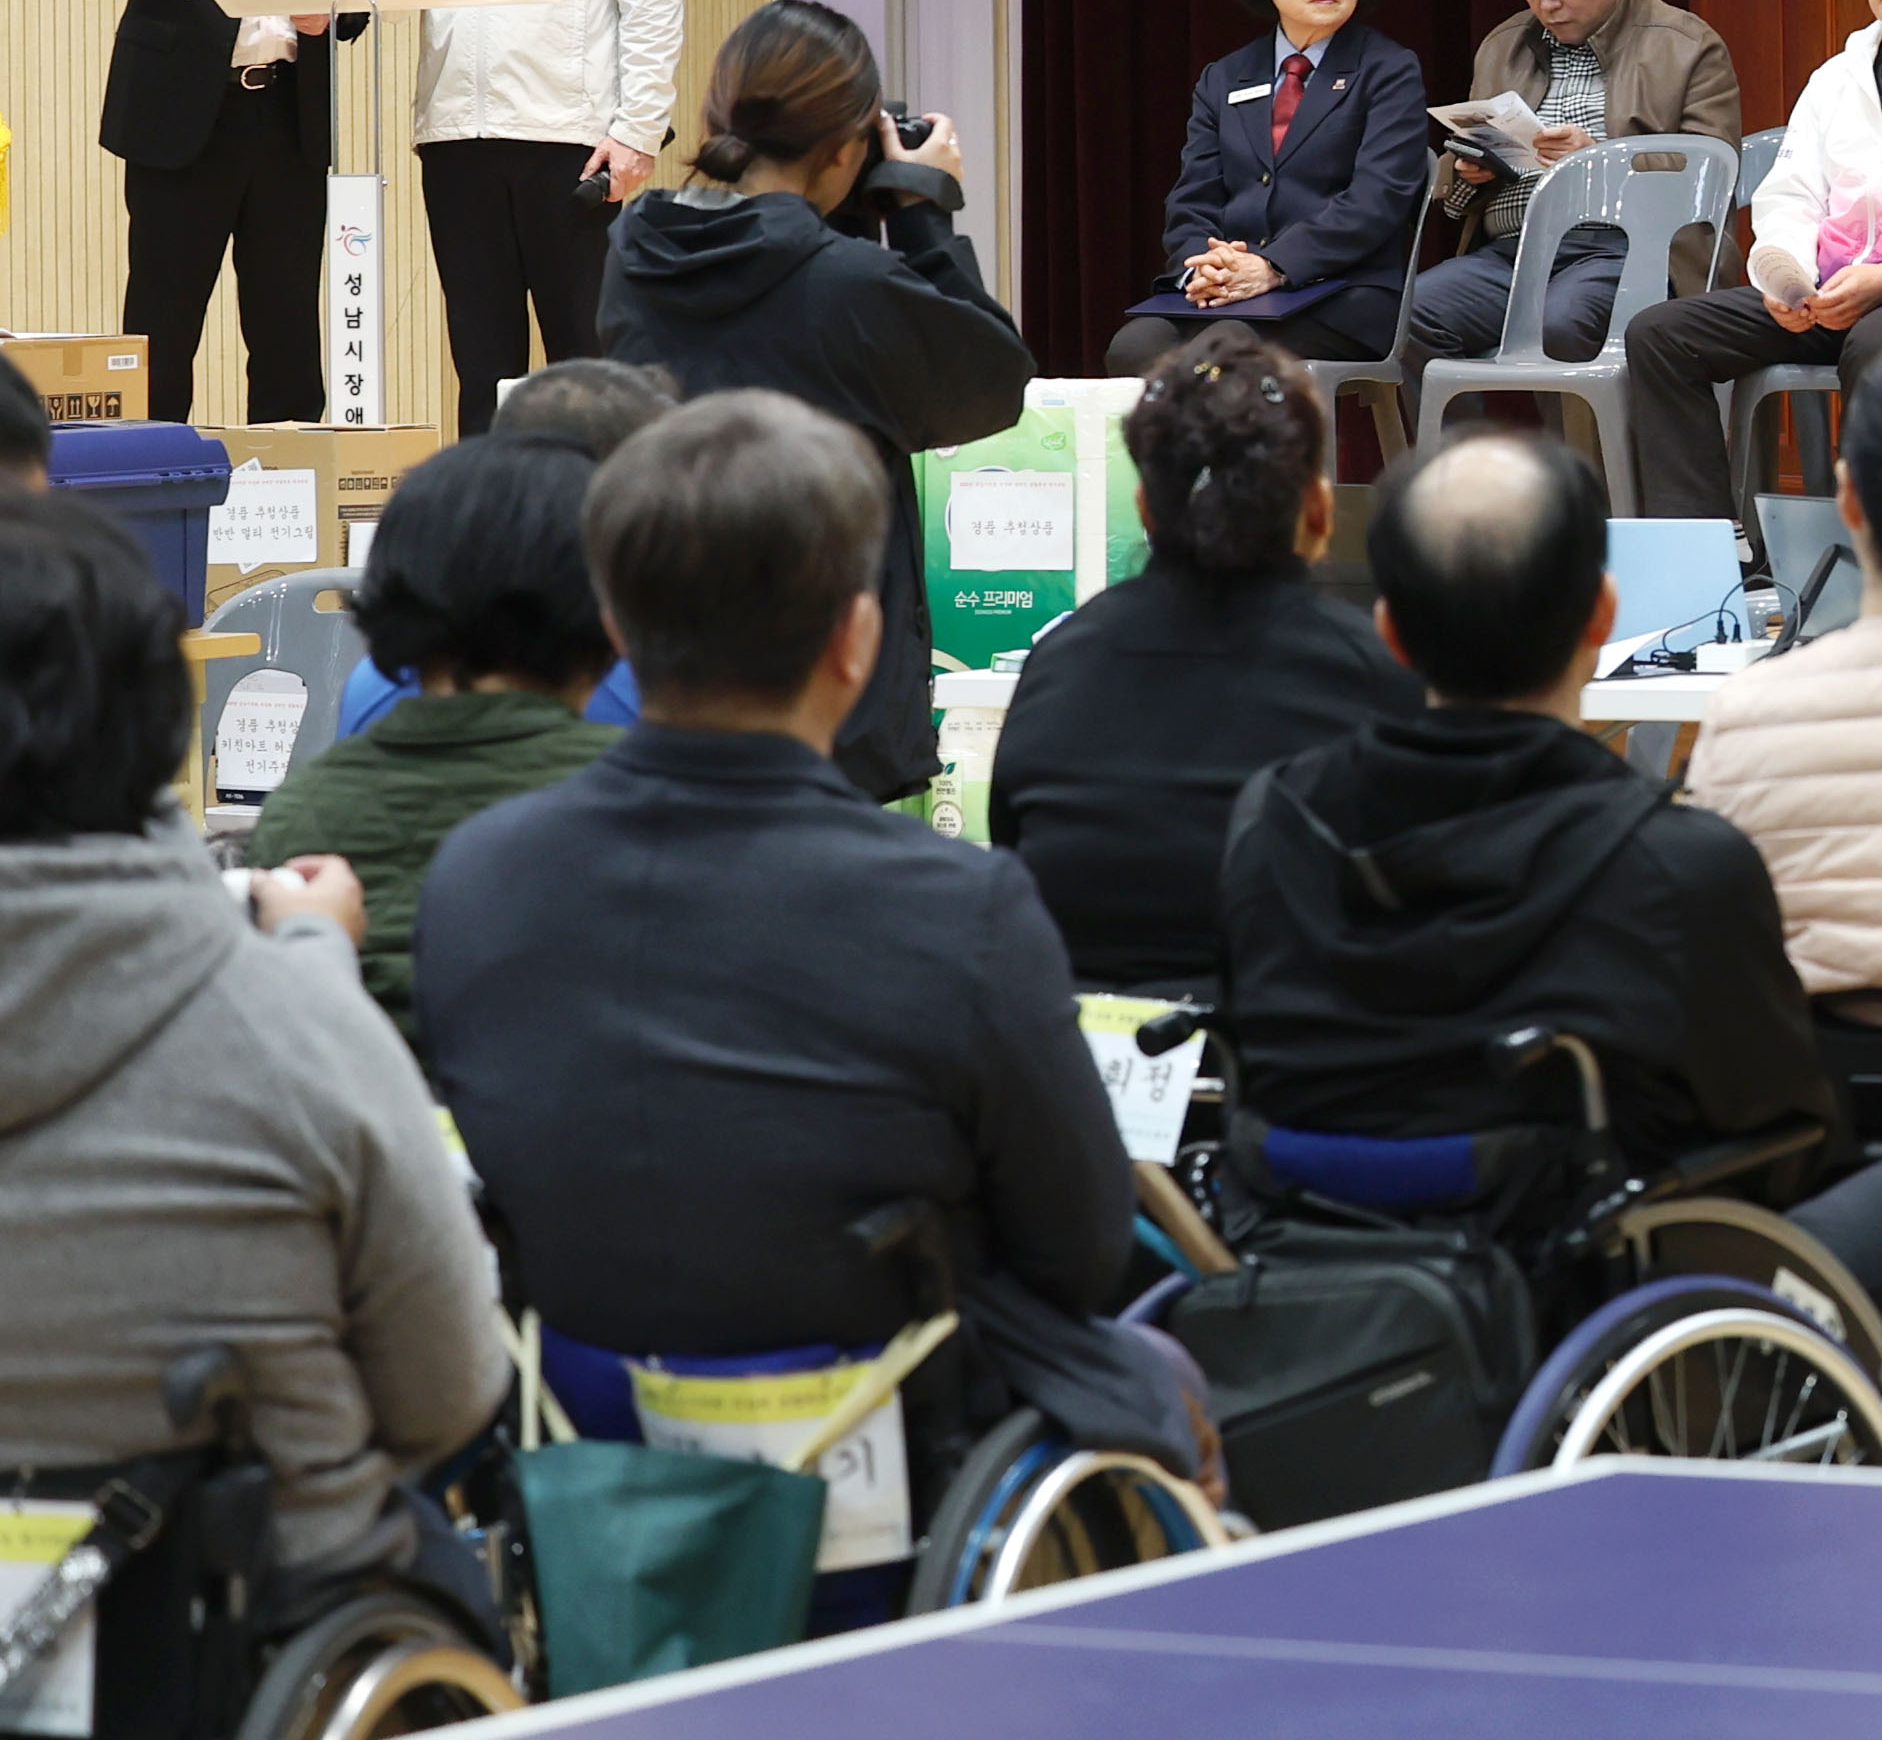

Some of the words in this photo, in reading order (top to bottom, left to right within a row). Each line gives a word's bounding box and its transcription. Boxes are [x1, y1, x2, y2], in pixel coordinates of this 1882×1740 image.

[344, 272, 364, 425] 성남시장애
[226, 505, 248, 521] 경품
[212, 525, 235, 541] 반반
[971, 519, 996, 536] 경품
[1003, 519, 1054, 536] 추첨상품
[954, 590, 981, 608] 순수
[982, 590, 1033, 608] 프리미엄
[236, 718, 259, 733] 경품
